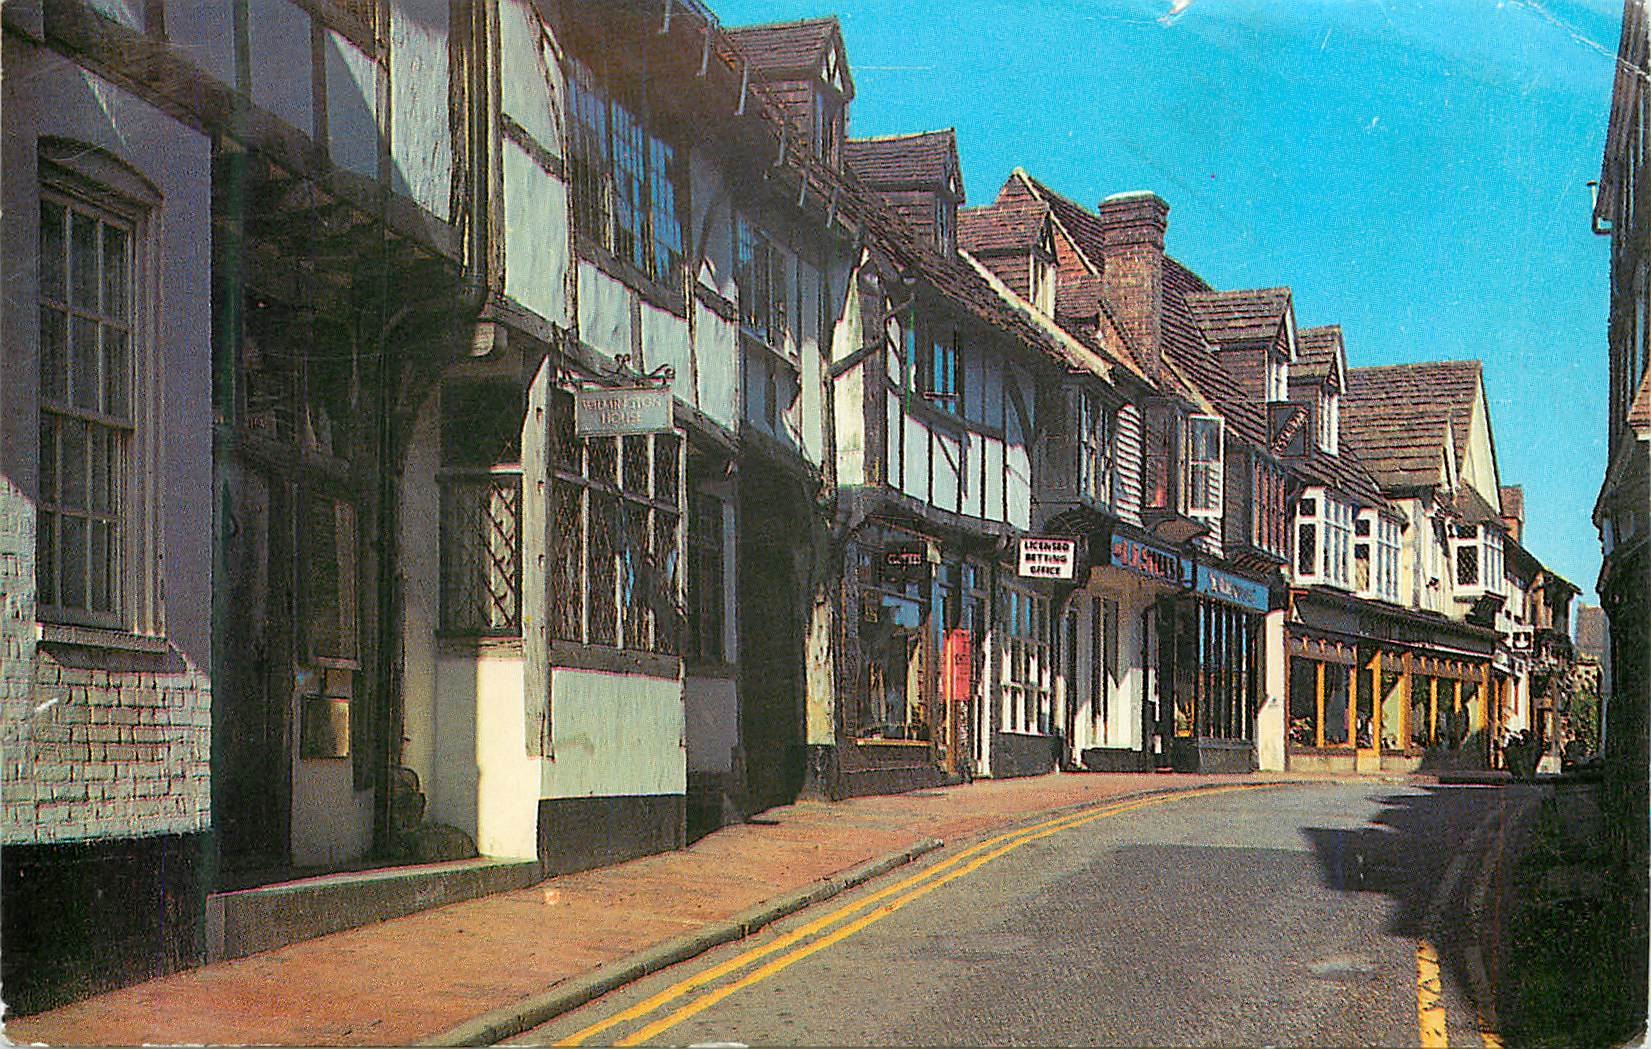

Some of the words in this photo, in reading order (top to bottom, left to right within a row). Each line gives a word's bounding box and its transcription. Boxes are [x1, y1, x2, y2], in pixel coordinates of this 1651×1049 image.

[1024, 541, 1070, 551] LICENSED
[1025, 553, 1068, 563] BETTING
[1029, 565, 1061, 575] OFFICE
